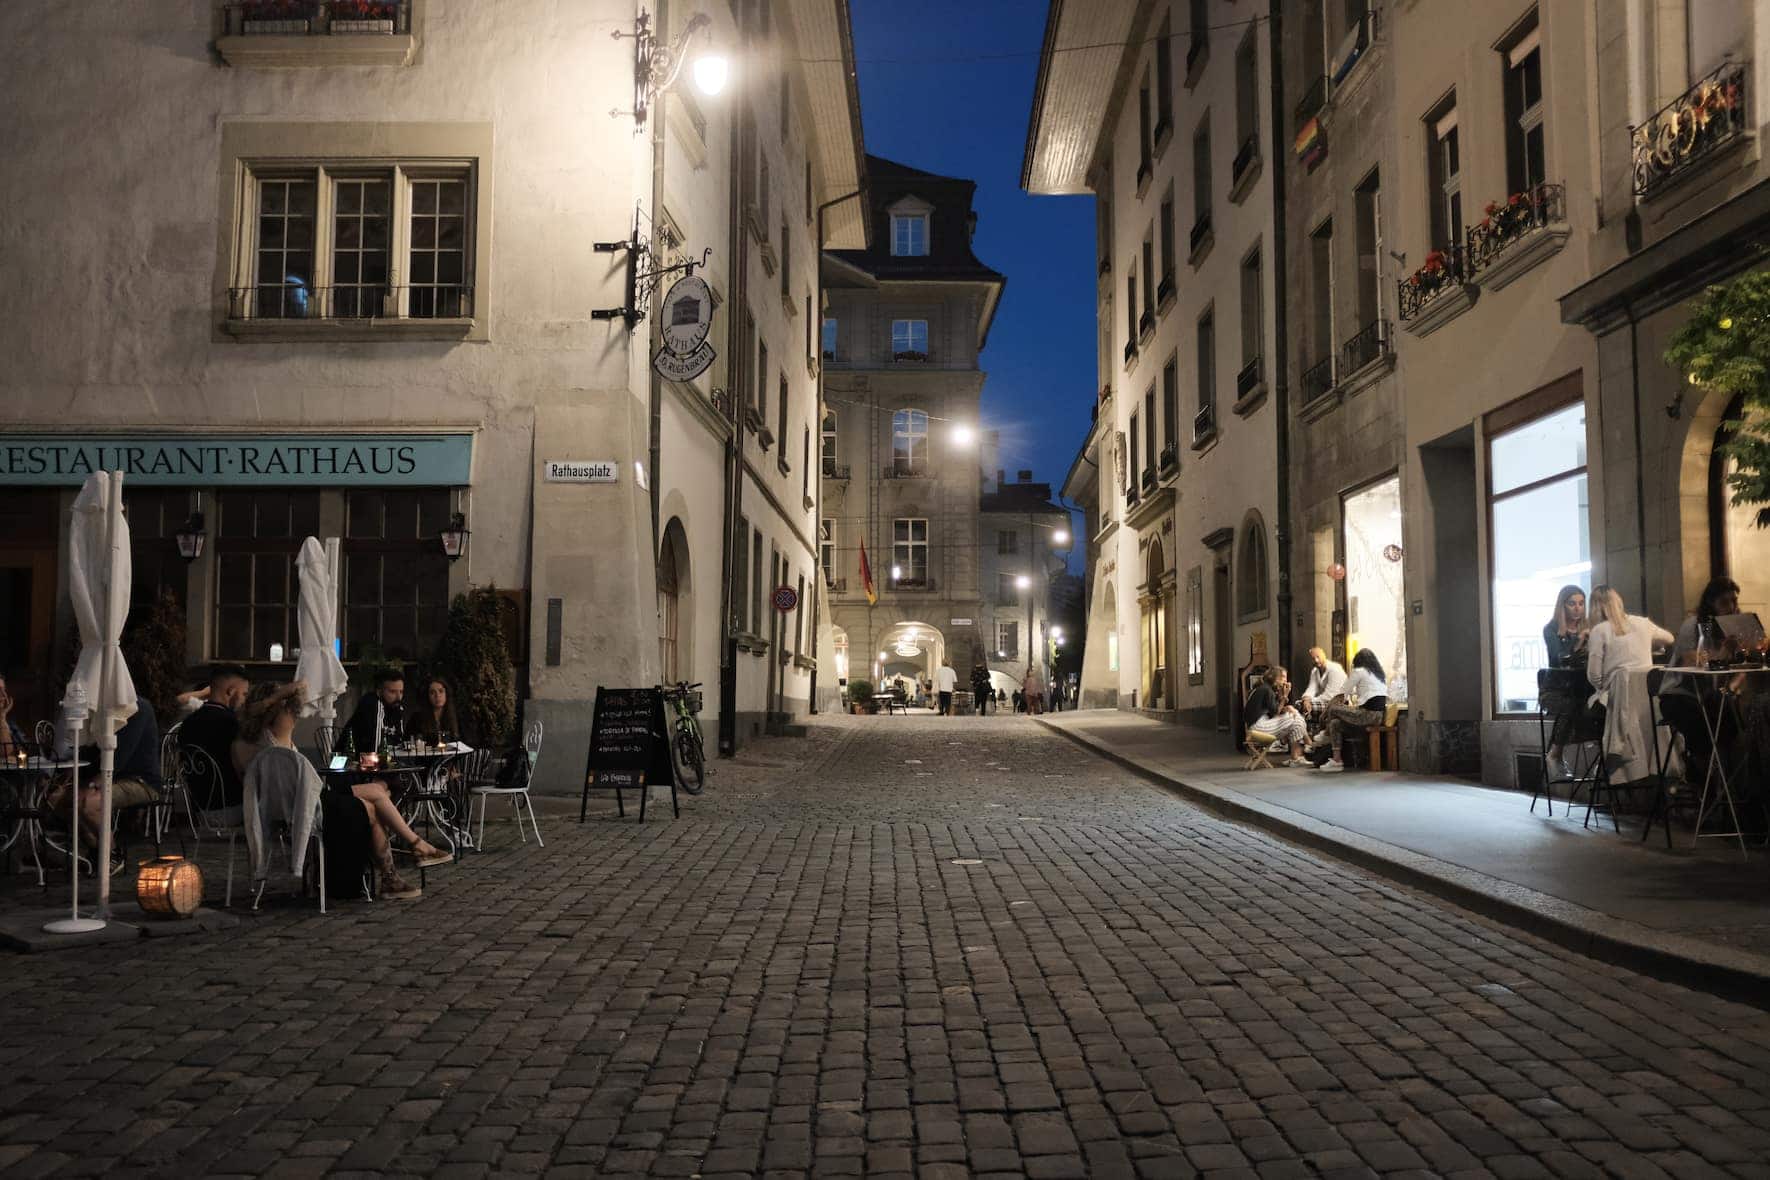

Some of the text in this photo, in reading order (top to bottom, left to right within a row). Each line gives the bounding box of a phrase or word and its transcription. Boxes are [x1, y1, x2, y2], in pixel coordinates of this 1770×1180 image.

[664, 321, 707, 350] RATHAUS
[0, 446, 416, 474] ESTAURANT RATHAUS
[551, 463, 612, 479] Rathausplatz
